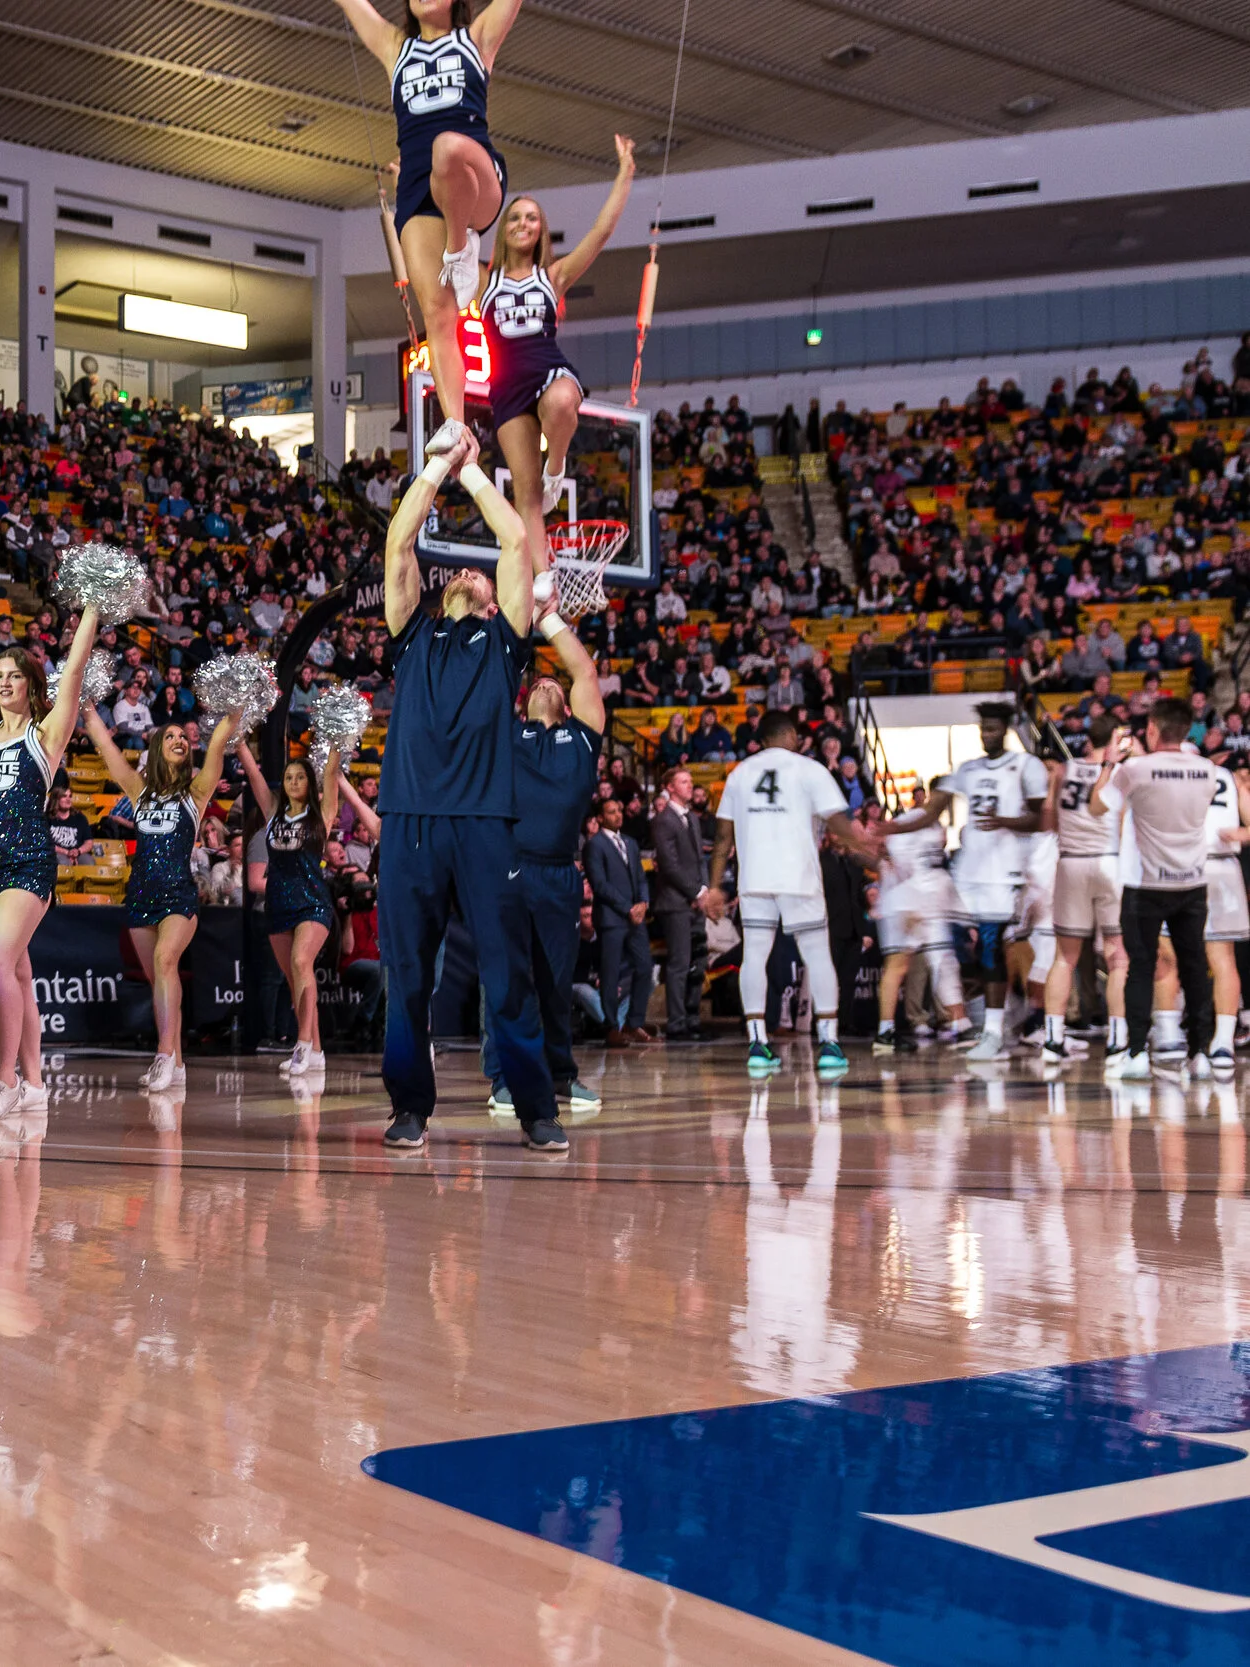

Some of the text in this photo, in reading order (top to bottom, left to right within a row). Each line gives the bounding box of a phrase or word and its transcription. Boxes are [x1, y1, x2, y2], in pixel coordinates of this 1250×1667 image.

[400, 68, 467, 103] STATE
[493, 304, 547, 328] STATE
[36, 334, 49, 352] T
[464, 320, 491, 383] 3
[330, 380, 341, 396] U
[1187, 768, 1209, 780] TEAM
[754, 768, 781, 804] 4
[135, 810, 181, 823] STATE
